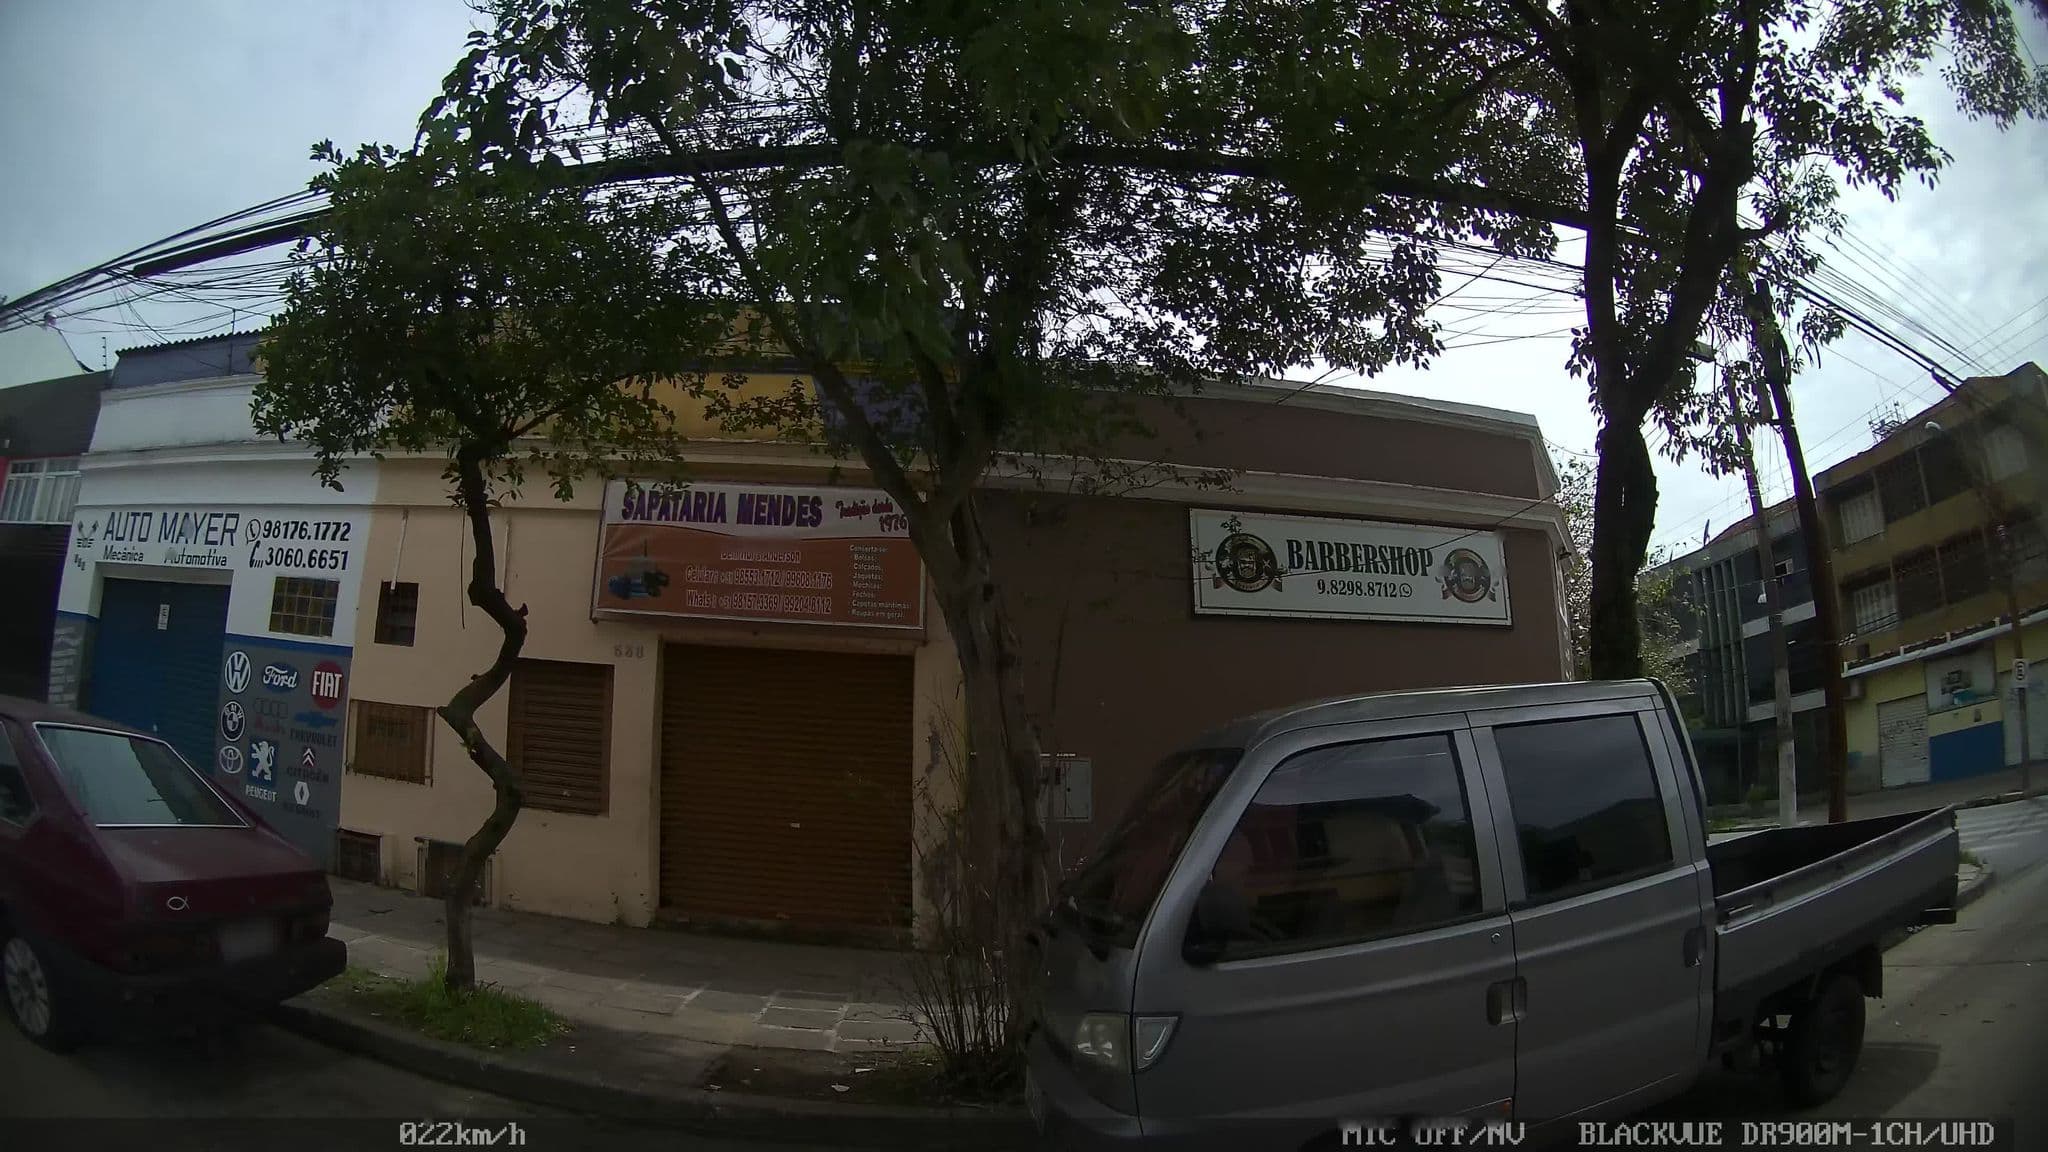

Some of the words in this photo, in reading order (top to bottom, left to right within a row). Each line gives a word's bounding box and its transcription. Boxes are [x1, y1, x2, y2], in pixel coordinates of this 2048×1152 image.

[621, 489, 727, 524] SAPATARIA
[736, 492, 823, 528] MENDES
[103, 511, 153, 543] AUTO
[158, 511, 241, 546] MAYER
[261, 519, 352, 542] 98176.1772
[102, 545, 144, 563] Mecânica
[163, 549, 228, 567] Automotiva
[264, 547, 350, 570] 3060.6651
[1285, 538, 1434, 577] BARBERSHOP
[1316, 581, 1398, 599] 9.8298.8712
[262, 664, 298, 688] Ford
[311, 669, 343, 698] FIAT
[245, 784, 278, 803] PEUGEOT
